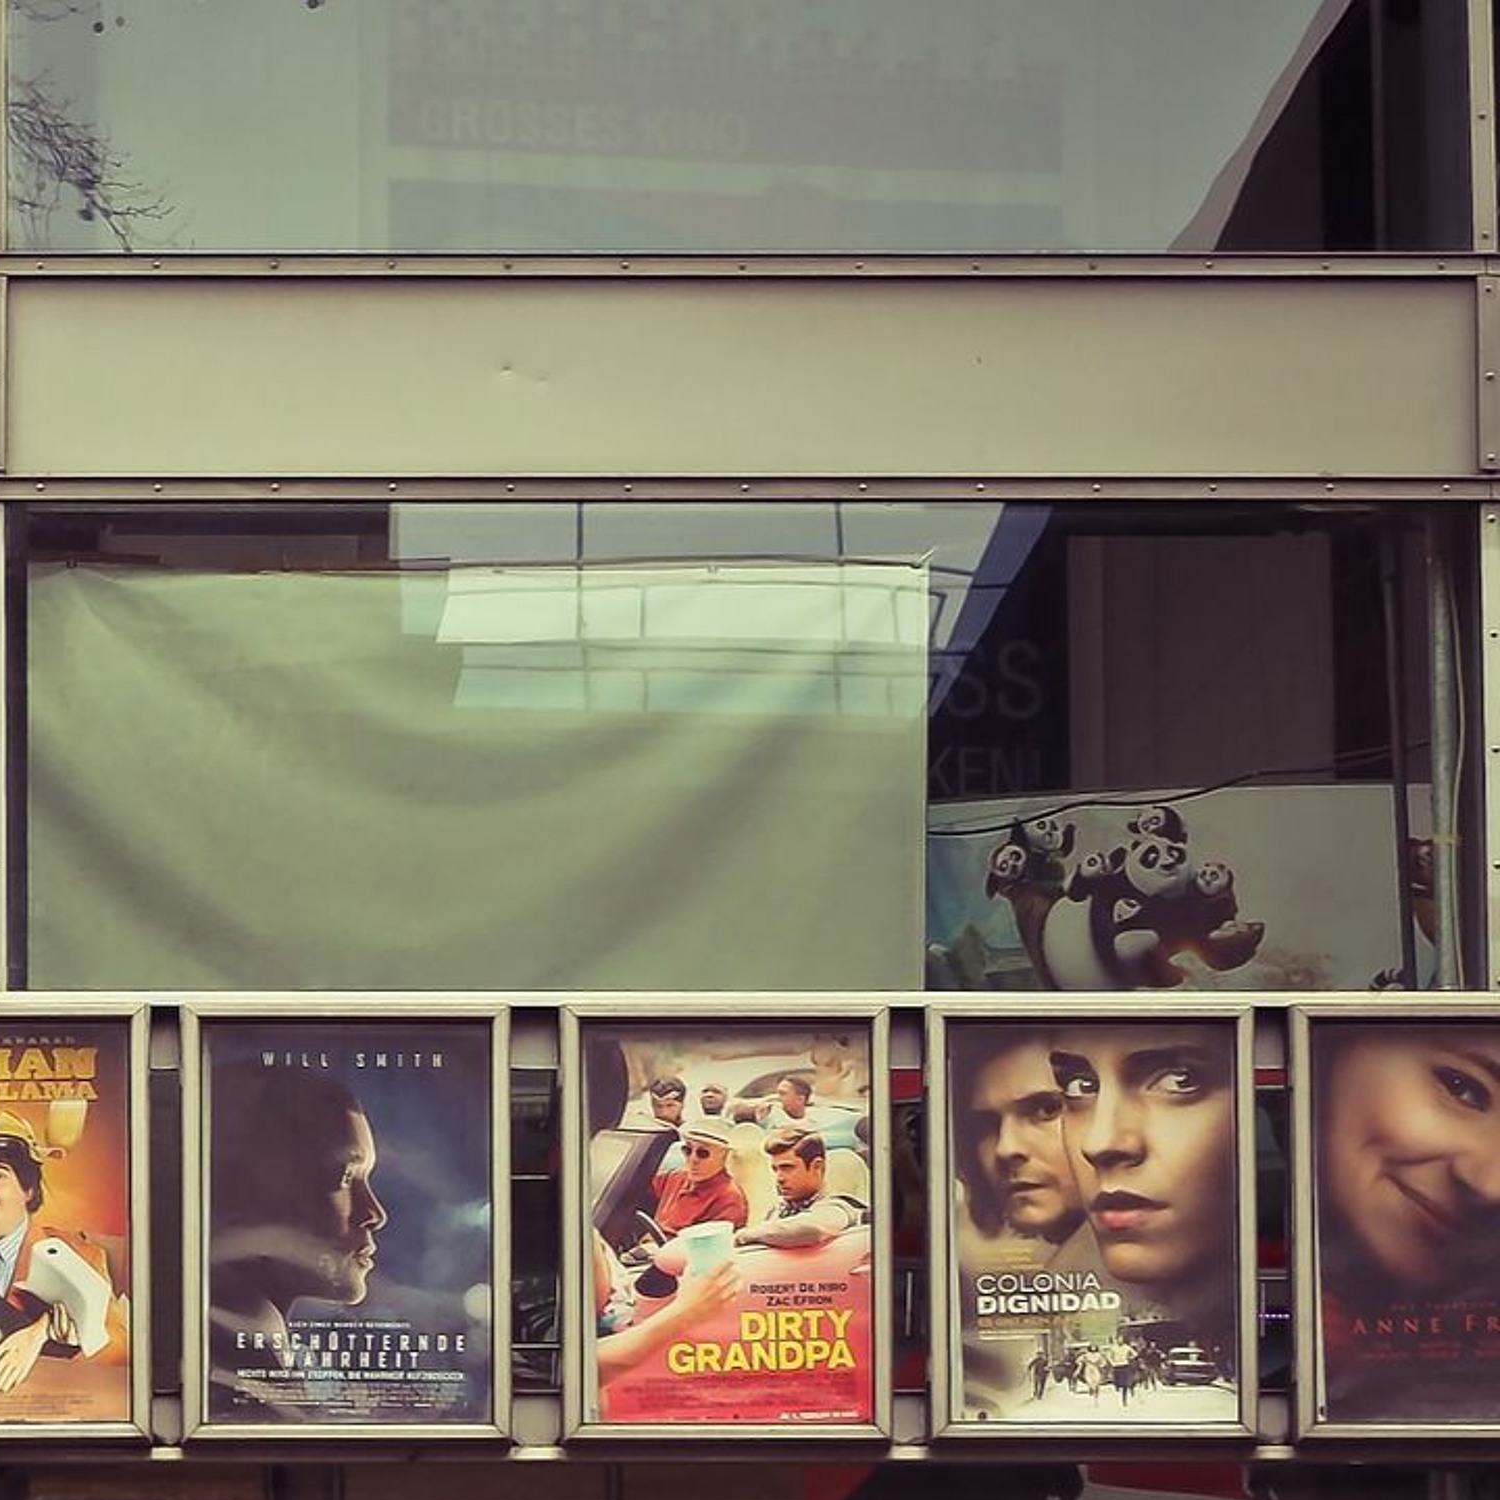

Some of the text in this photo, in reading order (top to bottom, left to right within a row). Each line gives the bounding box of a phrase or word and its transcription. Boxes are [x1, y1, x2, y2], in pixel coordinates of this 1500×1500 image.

[261, 1051, 443, 1068] WILL SMITH
[976, 1272, 1101, 1294] COLONIA
[976, 1291, 1122, 1315] DIGNIDAD
[740, 1308, 853, 1341] DIRTY
[1351, 1317, 1442, 1335] ANNE
[282, 1351, 419, 1368] WAHRHEIT
[666, 1340, 857, 1375] GRANDPA
